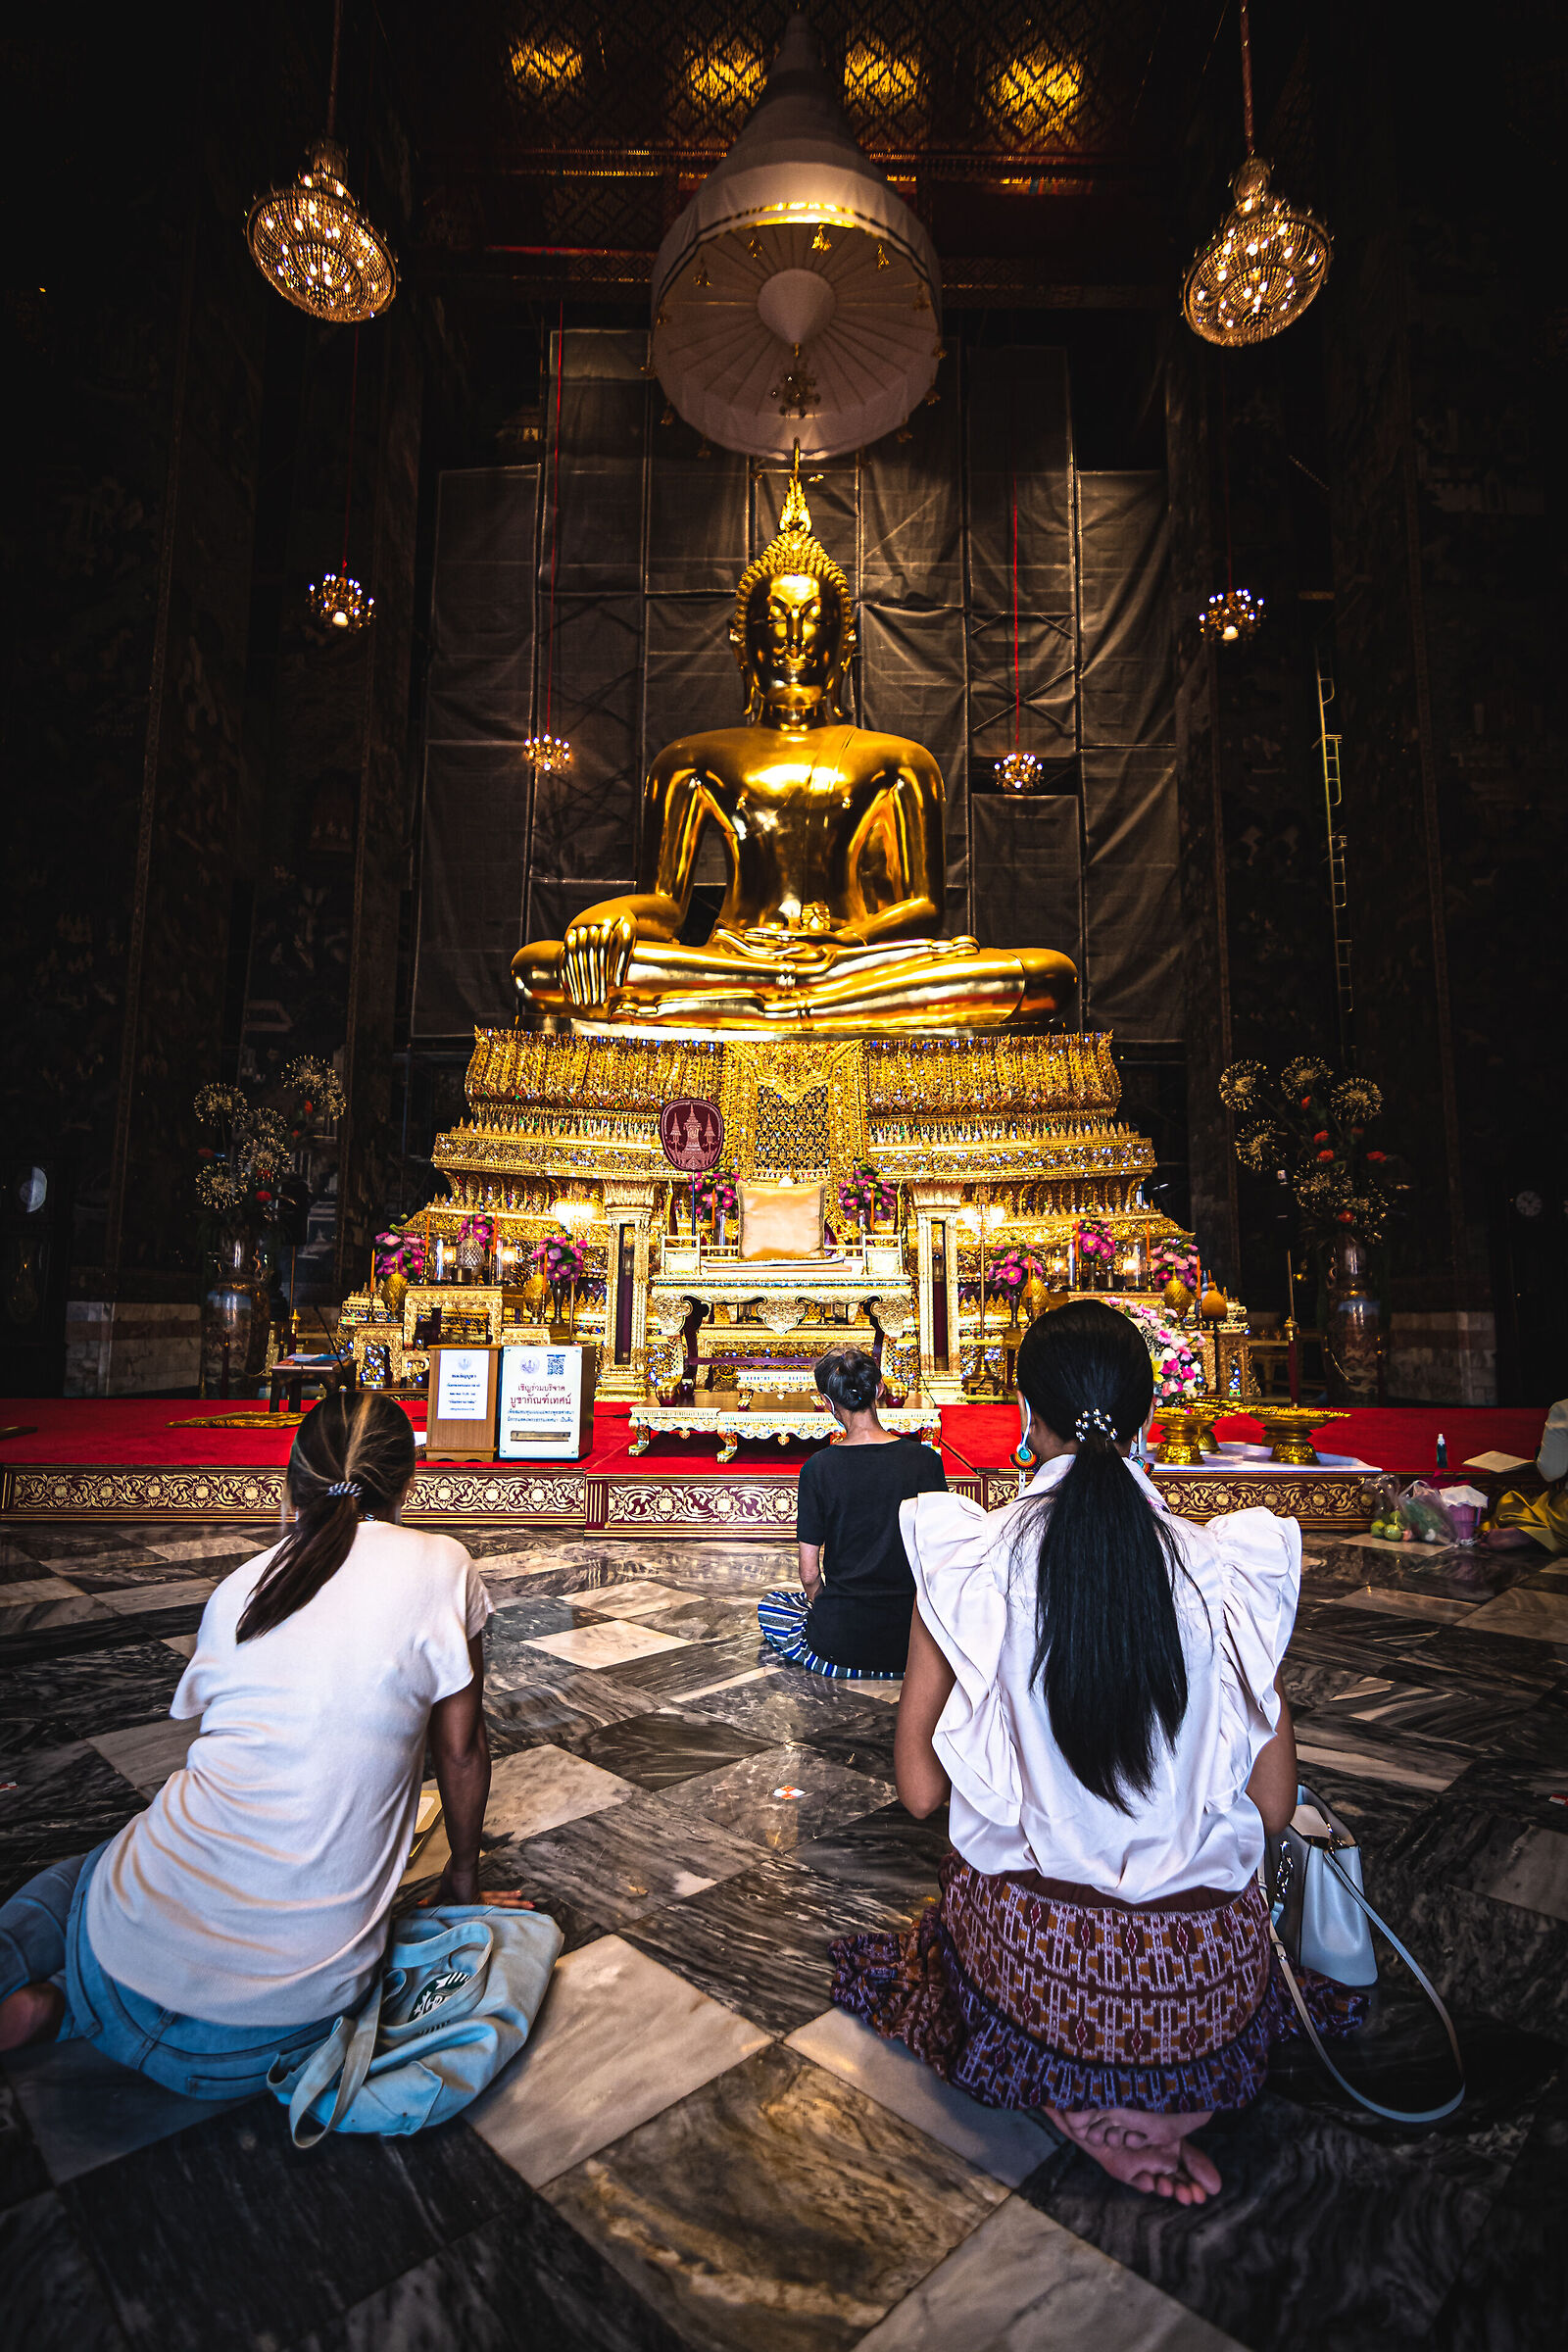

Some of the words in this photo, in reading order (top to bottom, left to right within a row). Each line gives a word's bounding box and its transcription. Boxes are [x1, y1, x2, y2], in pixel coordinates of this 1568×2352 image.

[517, 1383, 565, 1393] เชิญร่วมบริจาค
[510, 1393, 572, 1408] บูชากัณฑ์เทศน์
